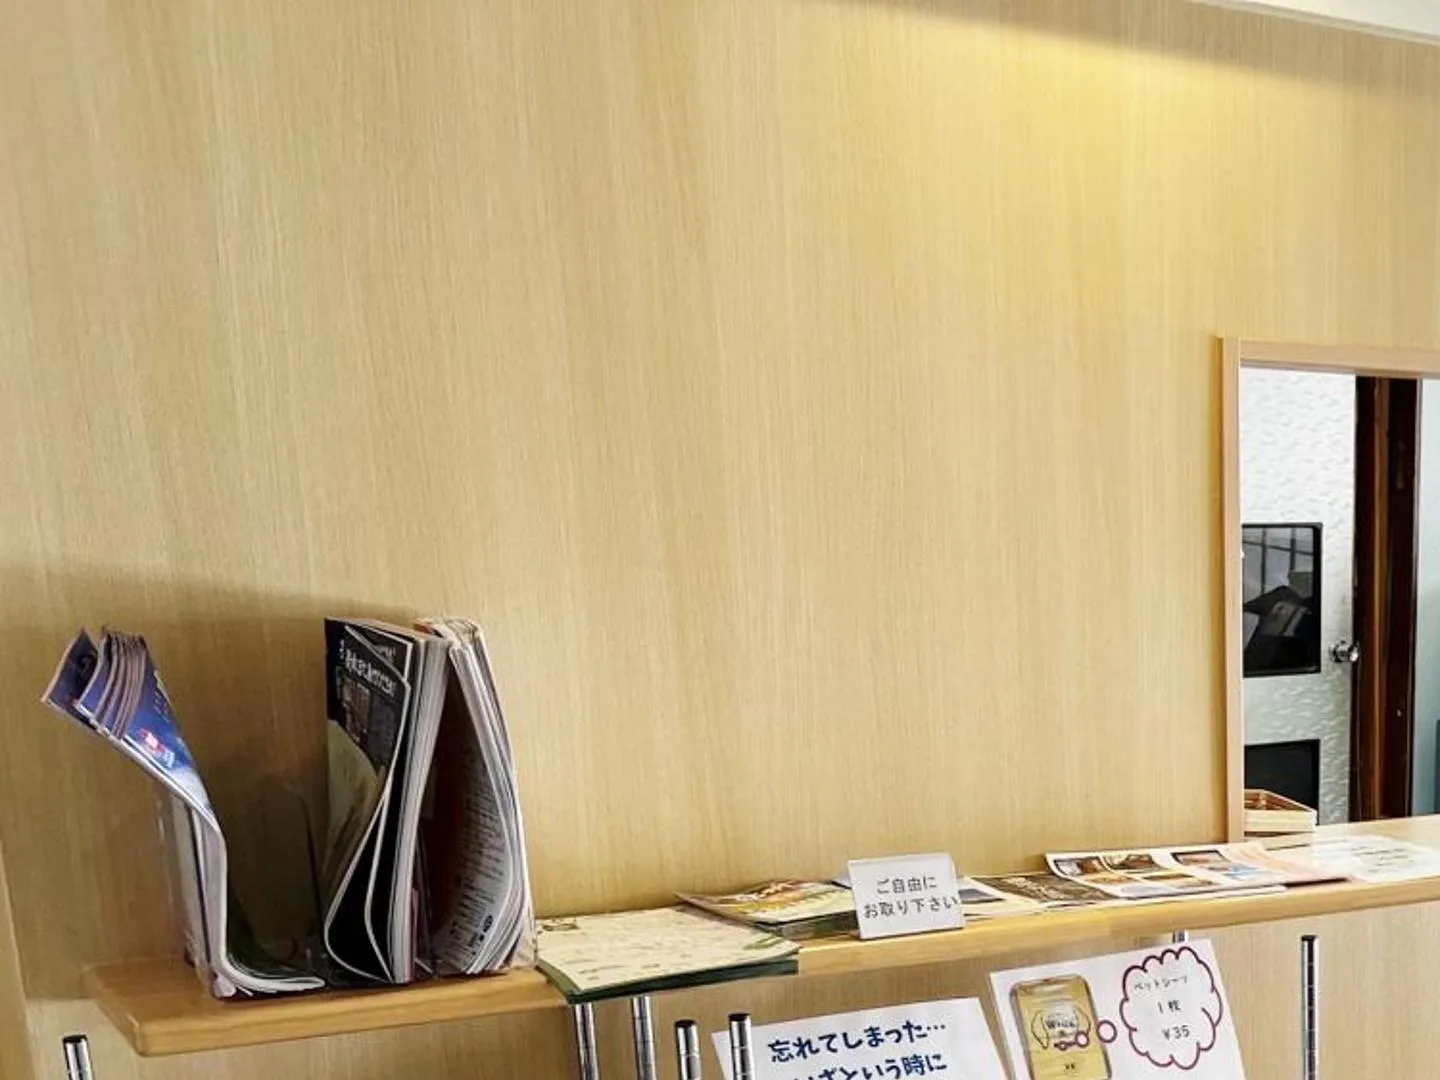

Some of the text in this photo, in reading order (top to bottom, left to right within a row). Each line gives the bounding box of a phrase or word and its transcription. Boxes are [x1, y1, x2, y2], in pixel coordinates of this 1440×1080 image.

[875, 875, 938, 895] ご自由に
[863, 895, 959, 919] お取り下さい
[1162, 1024, 1191, 1041] ¥35
